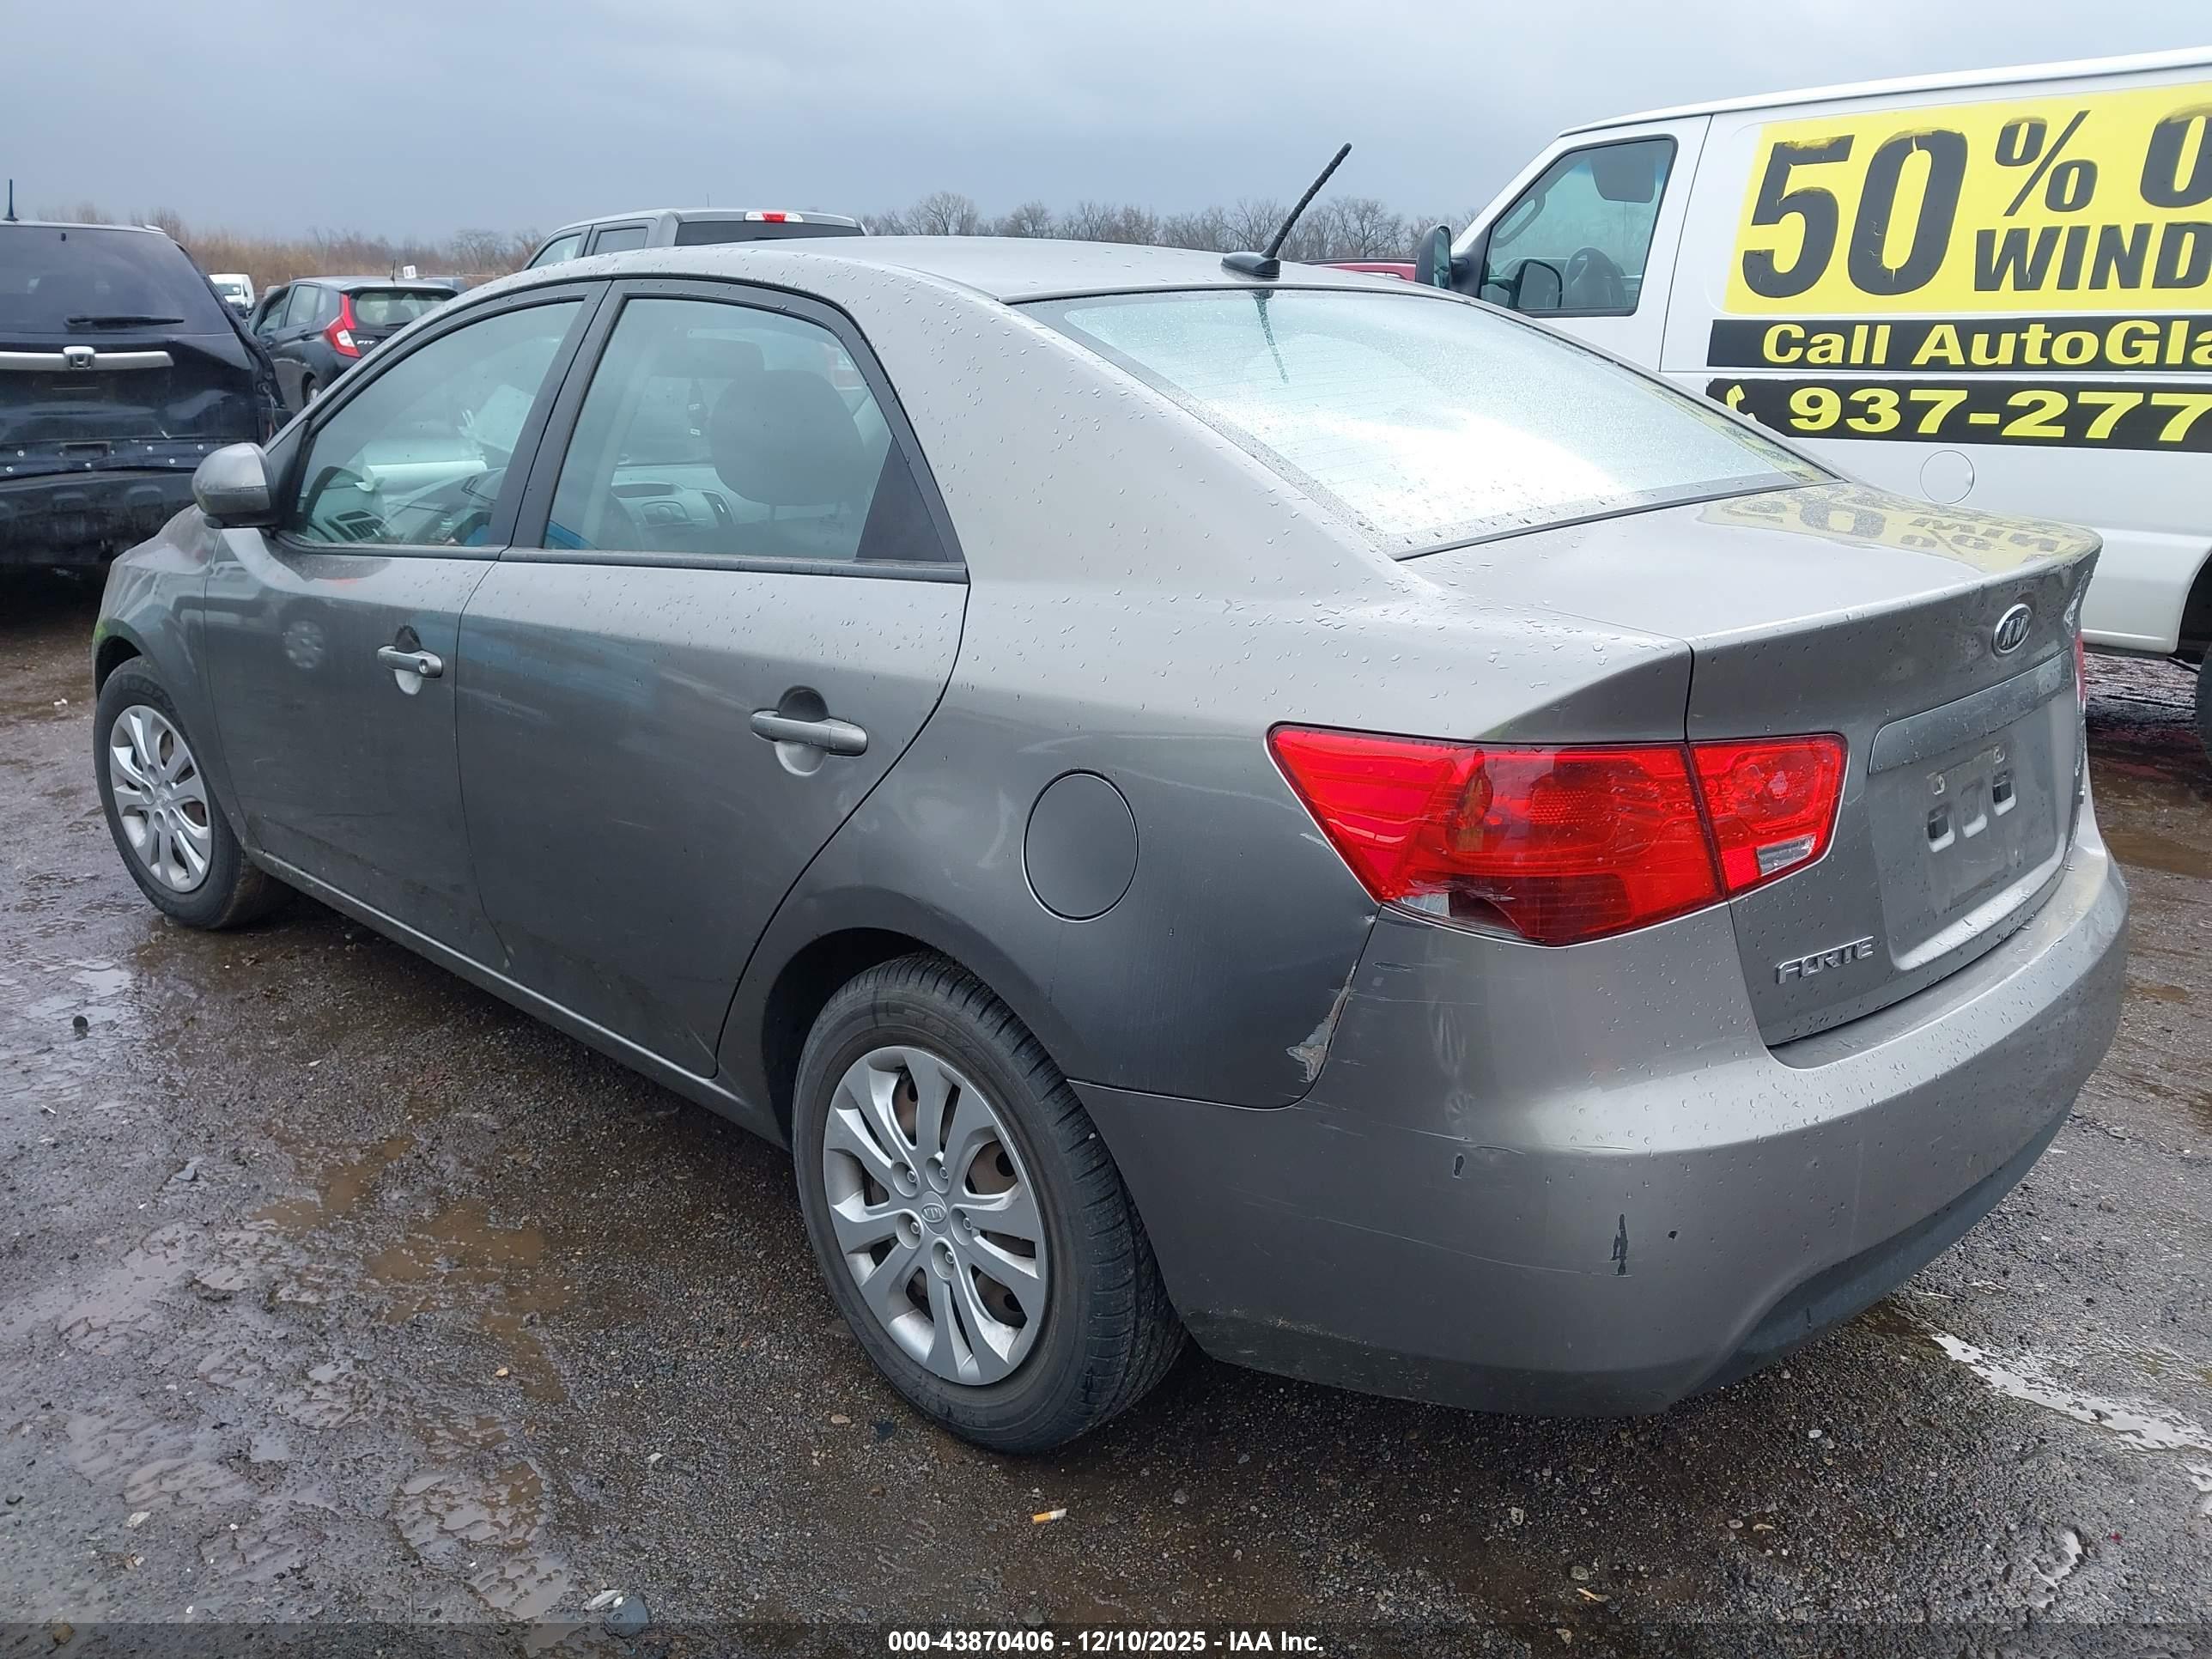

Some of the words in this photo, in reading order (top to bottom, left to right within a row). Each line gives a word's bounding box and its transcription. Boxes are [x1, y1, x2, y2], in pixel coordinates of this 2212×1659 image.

[1742, 110, 2098, 298] 50%
[1763, 324, 1891, 364] Call
[1789, 387, 2212, 441] 937-277
[1775, 935, 1875, 984] FORTE
